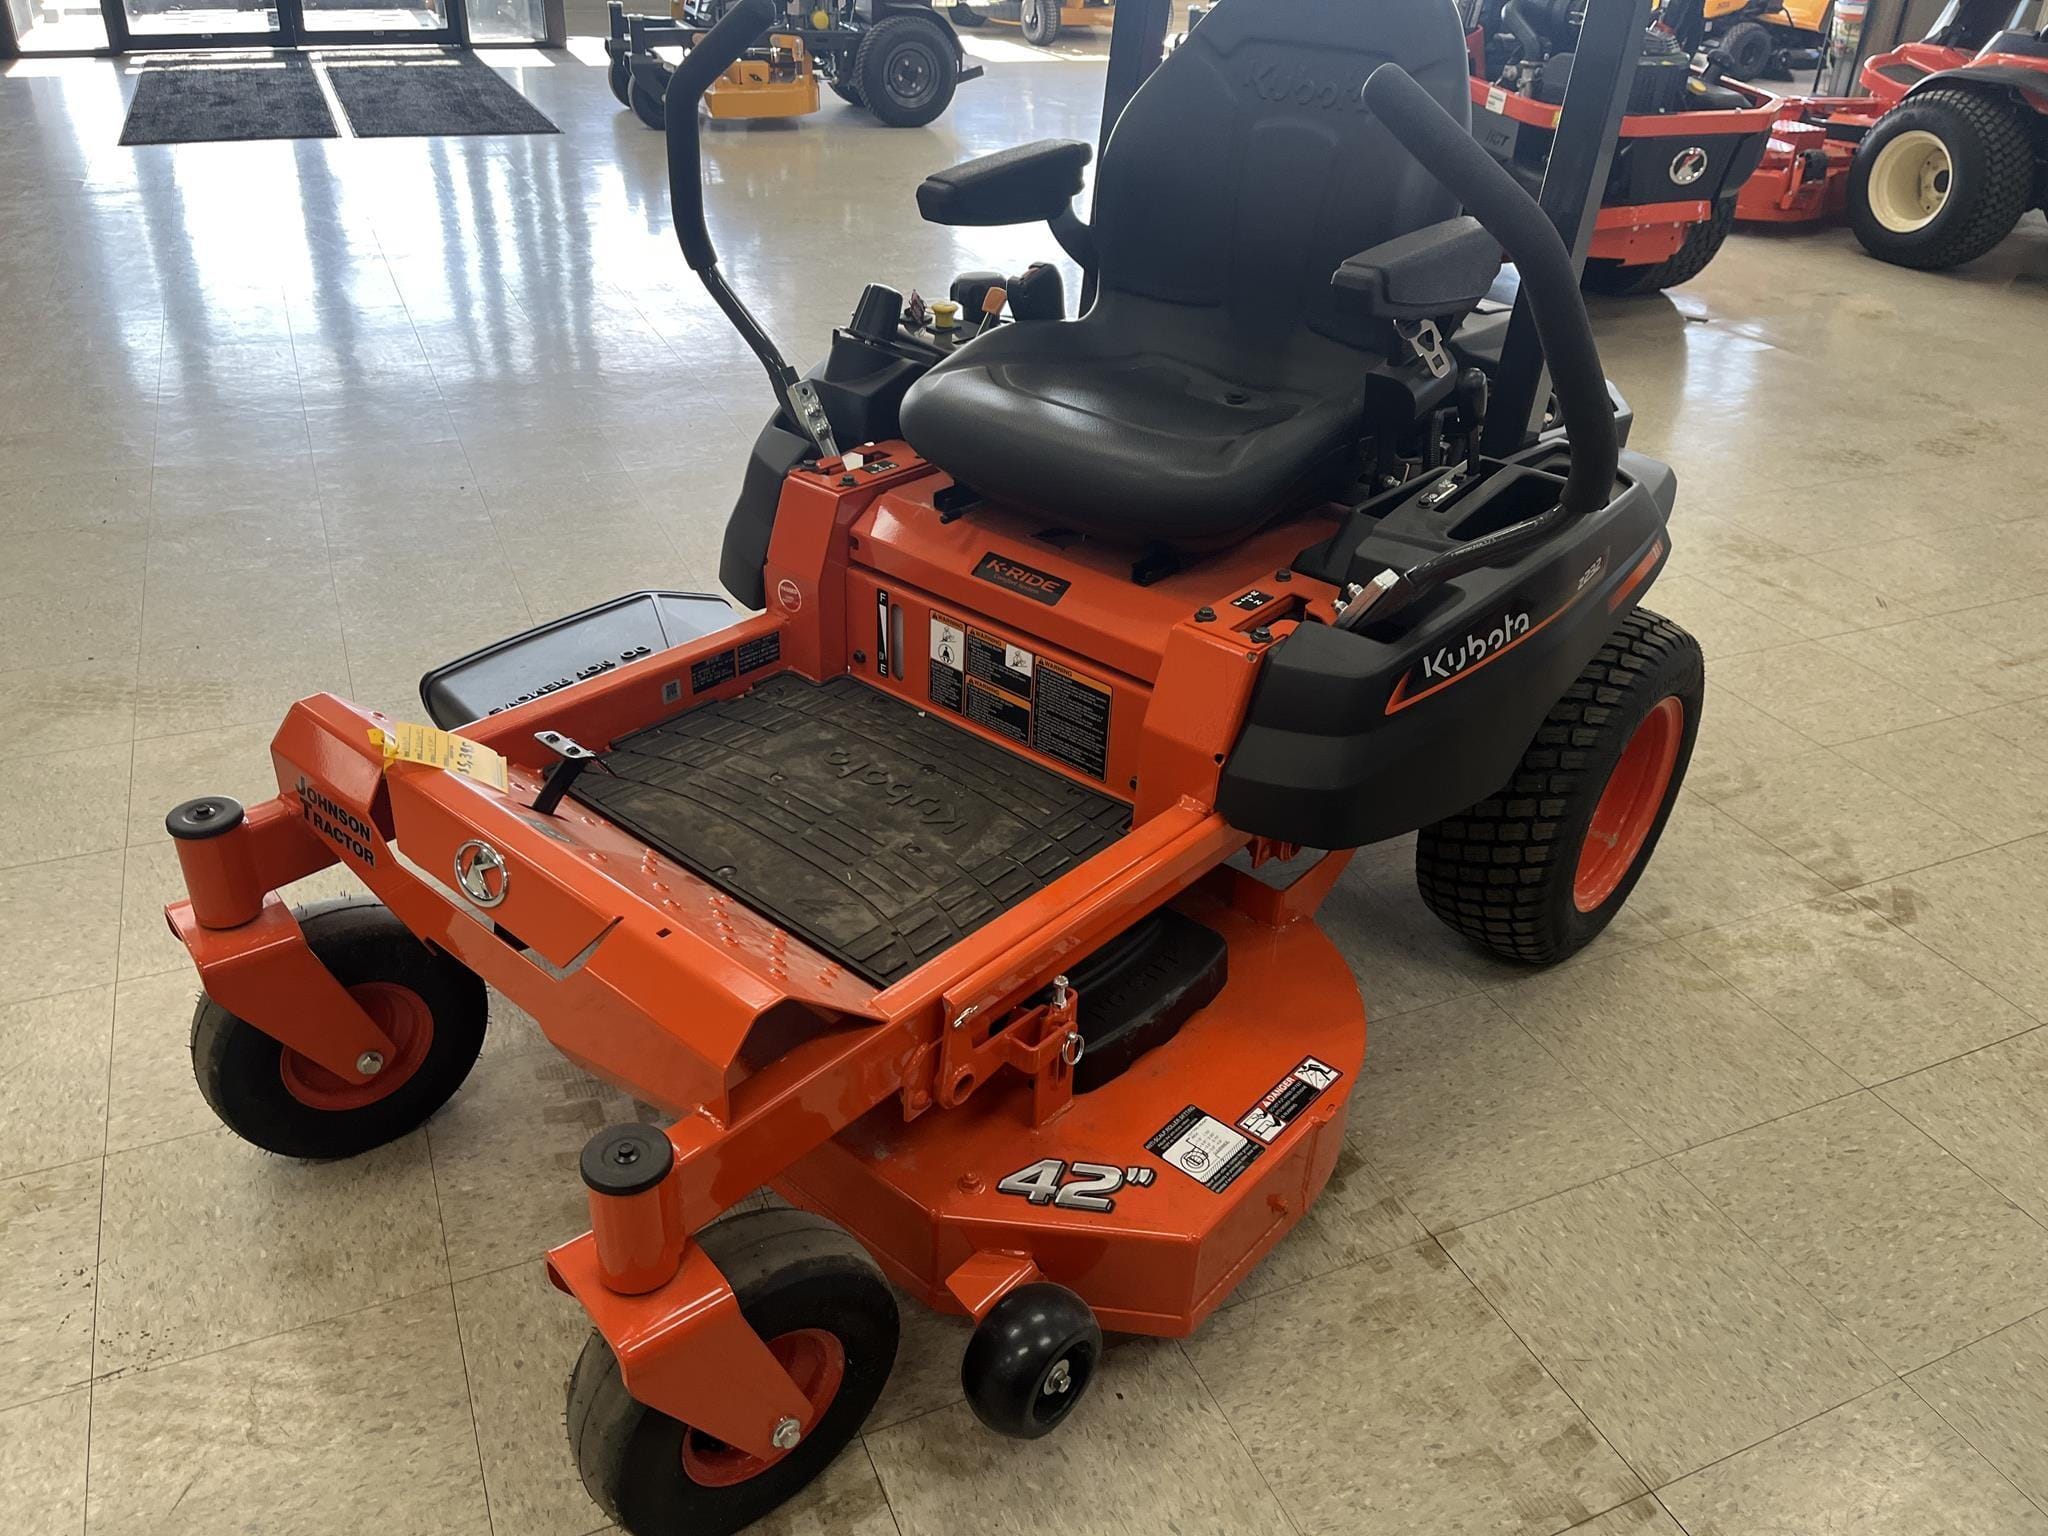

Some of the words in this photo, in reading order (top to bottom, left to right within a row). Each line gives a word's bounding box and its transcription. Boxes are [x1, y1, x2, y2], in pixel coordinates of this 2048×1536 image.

[986, 559, 1061, 594] K-RIDE
[880, 592, 886, 602] F
[936, 614, 964, 631] WARNING
[975, 630, 1002, 648] WARNING
[1423, 612, 1530, 678] Kubota
[620, 644, 651, 662] DO
[576, 659, 616, 680] NOT
[880, 663, 887, 674] E
[1044, 659, 1073, 678] WARNING
[973, 680, 1000, 696] WARNING
[823, 749, 969, 836] Kubota
[294, 775, 371, 842] JOHNSON
[299, 796, 376, 869] TRACTOR
[1266, 1075, 1296, 1103] DANGER
[998, 1157, 1154, 1212] 42"
